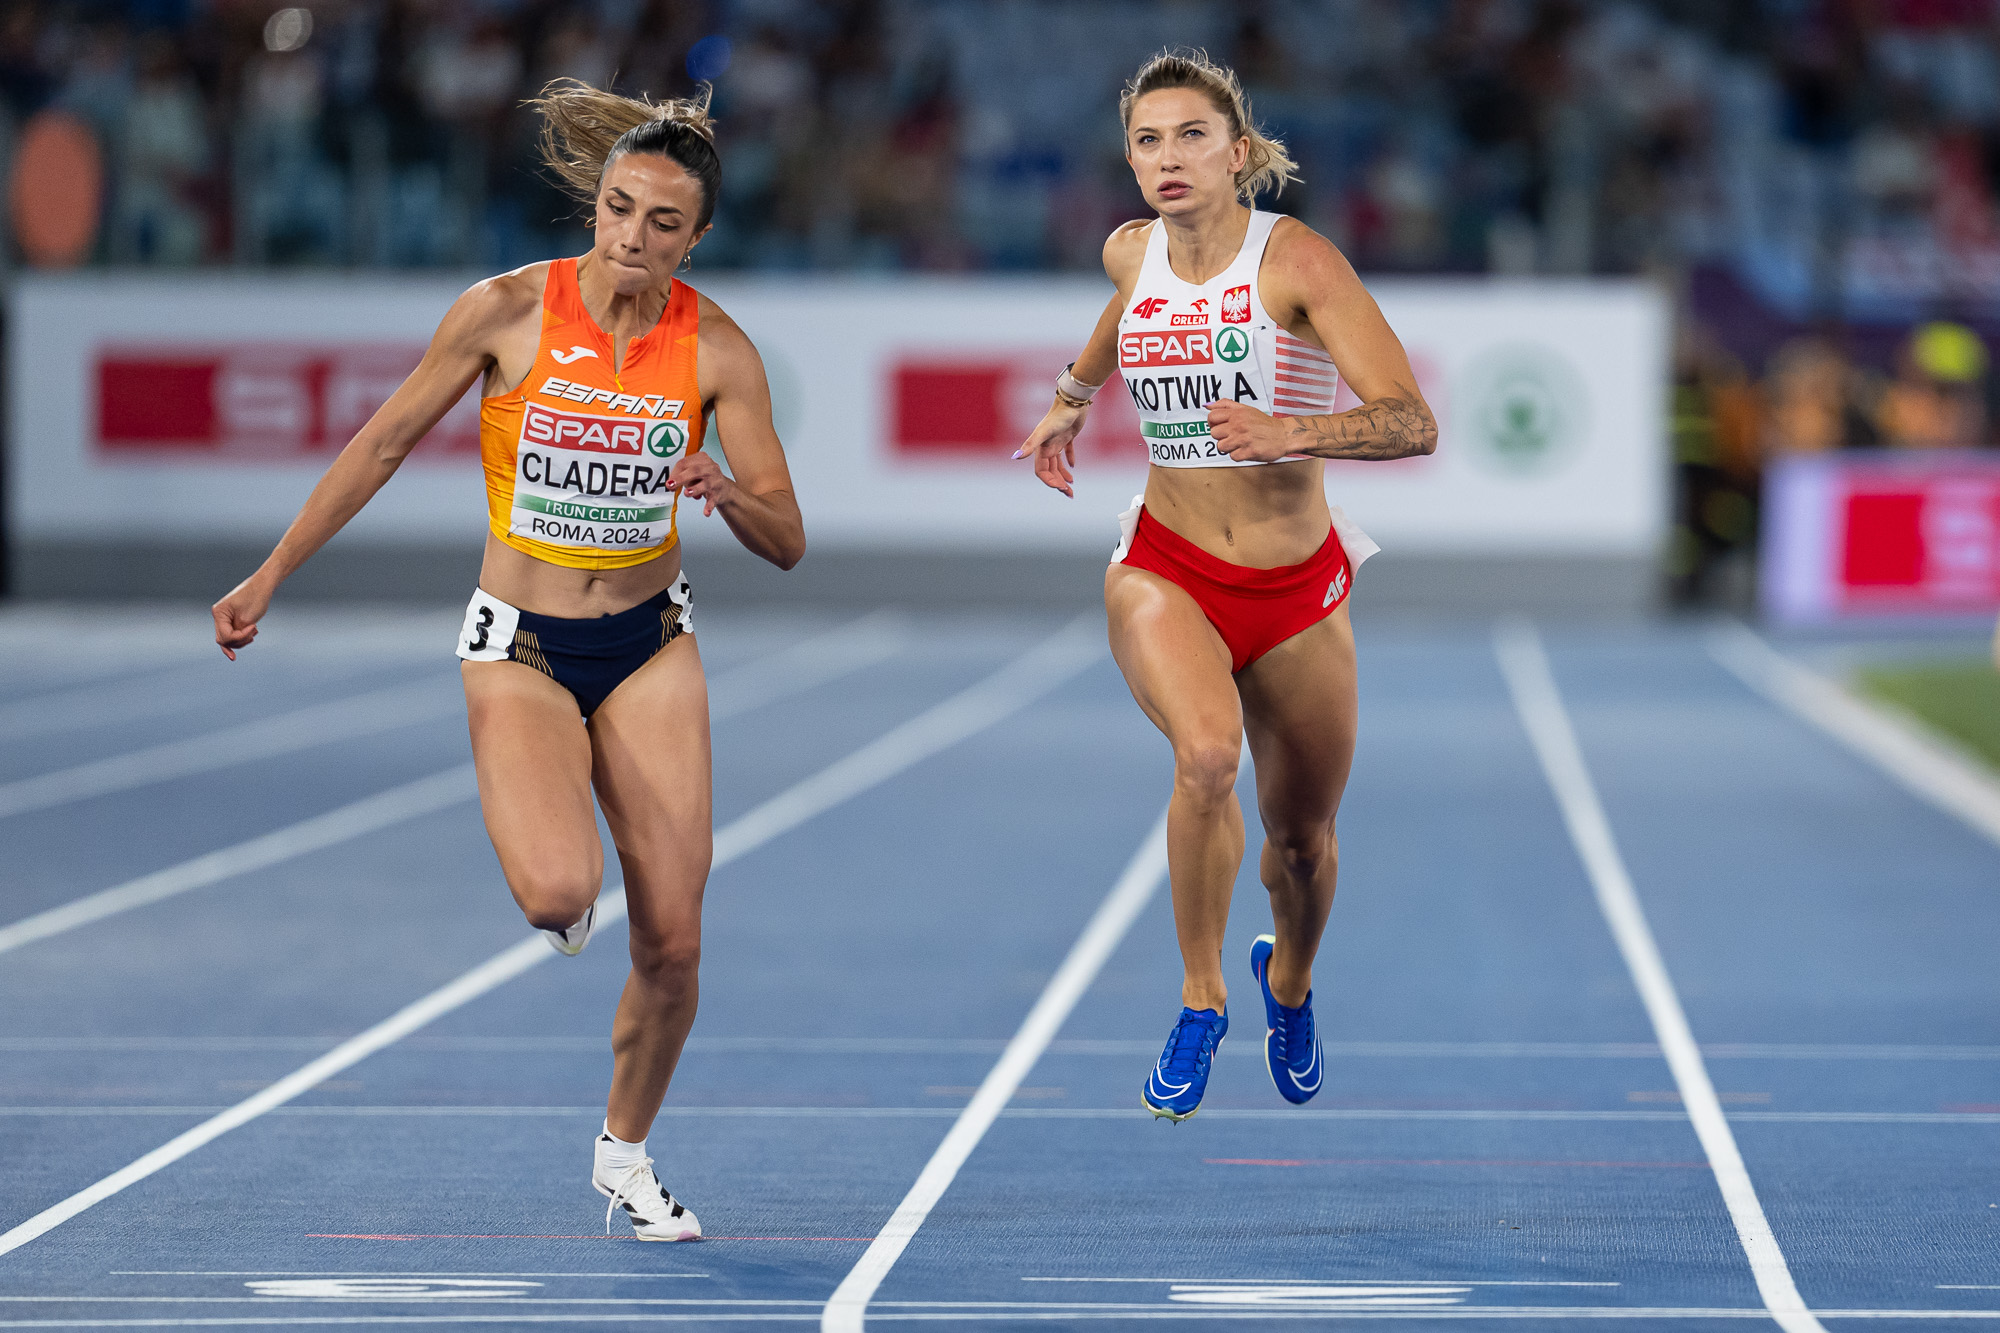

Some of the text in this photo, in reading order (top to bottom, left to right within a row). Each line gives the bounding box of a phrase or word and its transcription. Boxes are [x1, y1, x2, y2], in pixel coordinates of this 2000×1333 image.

[1132, 297, 1169, 319] 4F
[1172, 315, 1207, 325] ORLEN
[1121, 334, 1211, 363] SPAR
[538, 376, 685, 419] ESPAÑA
[527, 412, 641, 451] SPAR
[1160, 424, 1185, 437] RUN
[1186, 422, 1212, 436] CLE
[1151, 443, 1201, 460] ROMA
[521, 452, 671, 497] CLADERA
[552, 502, 586, 519] RUN
[532, 517, 651, 544] ROMA 2024
[1322, 564, 1347, 609] 4F
[468, 605, 495, 652] 3
